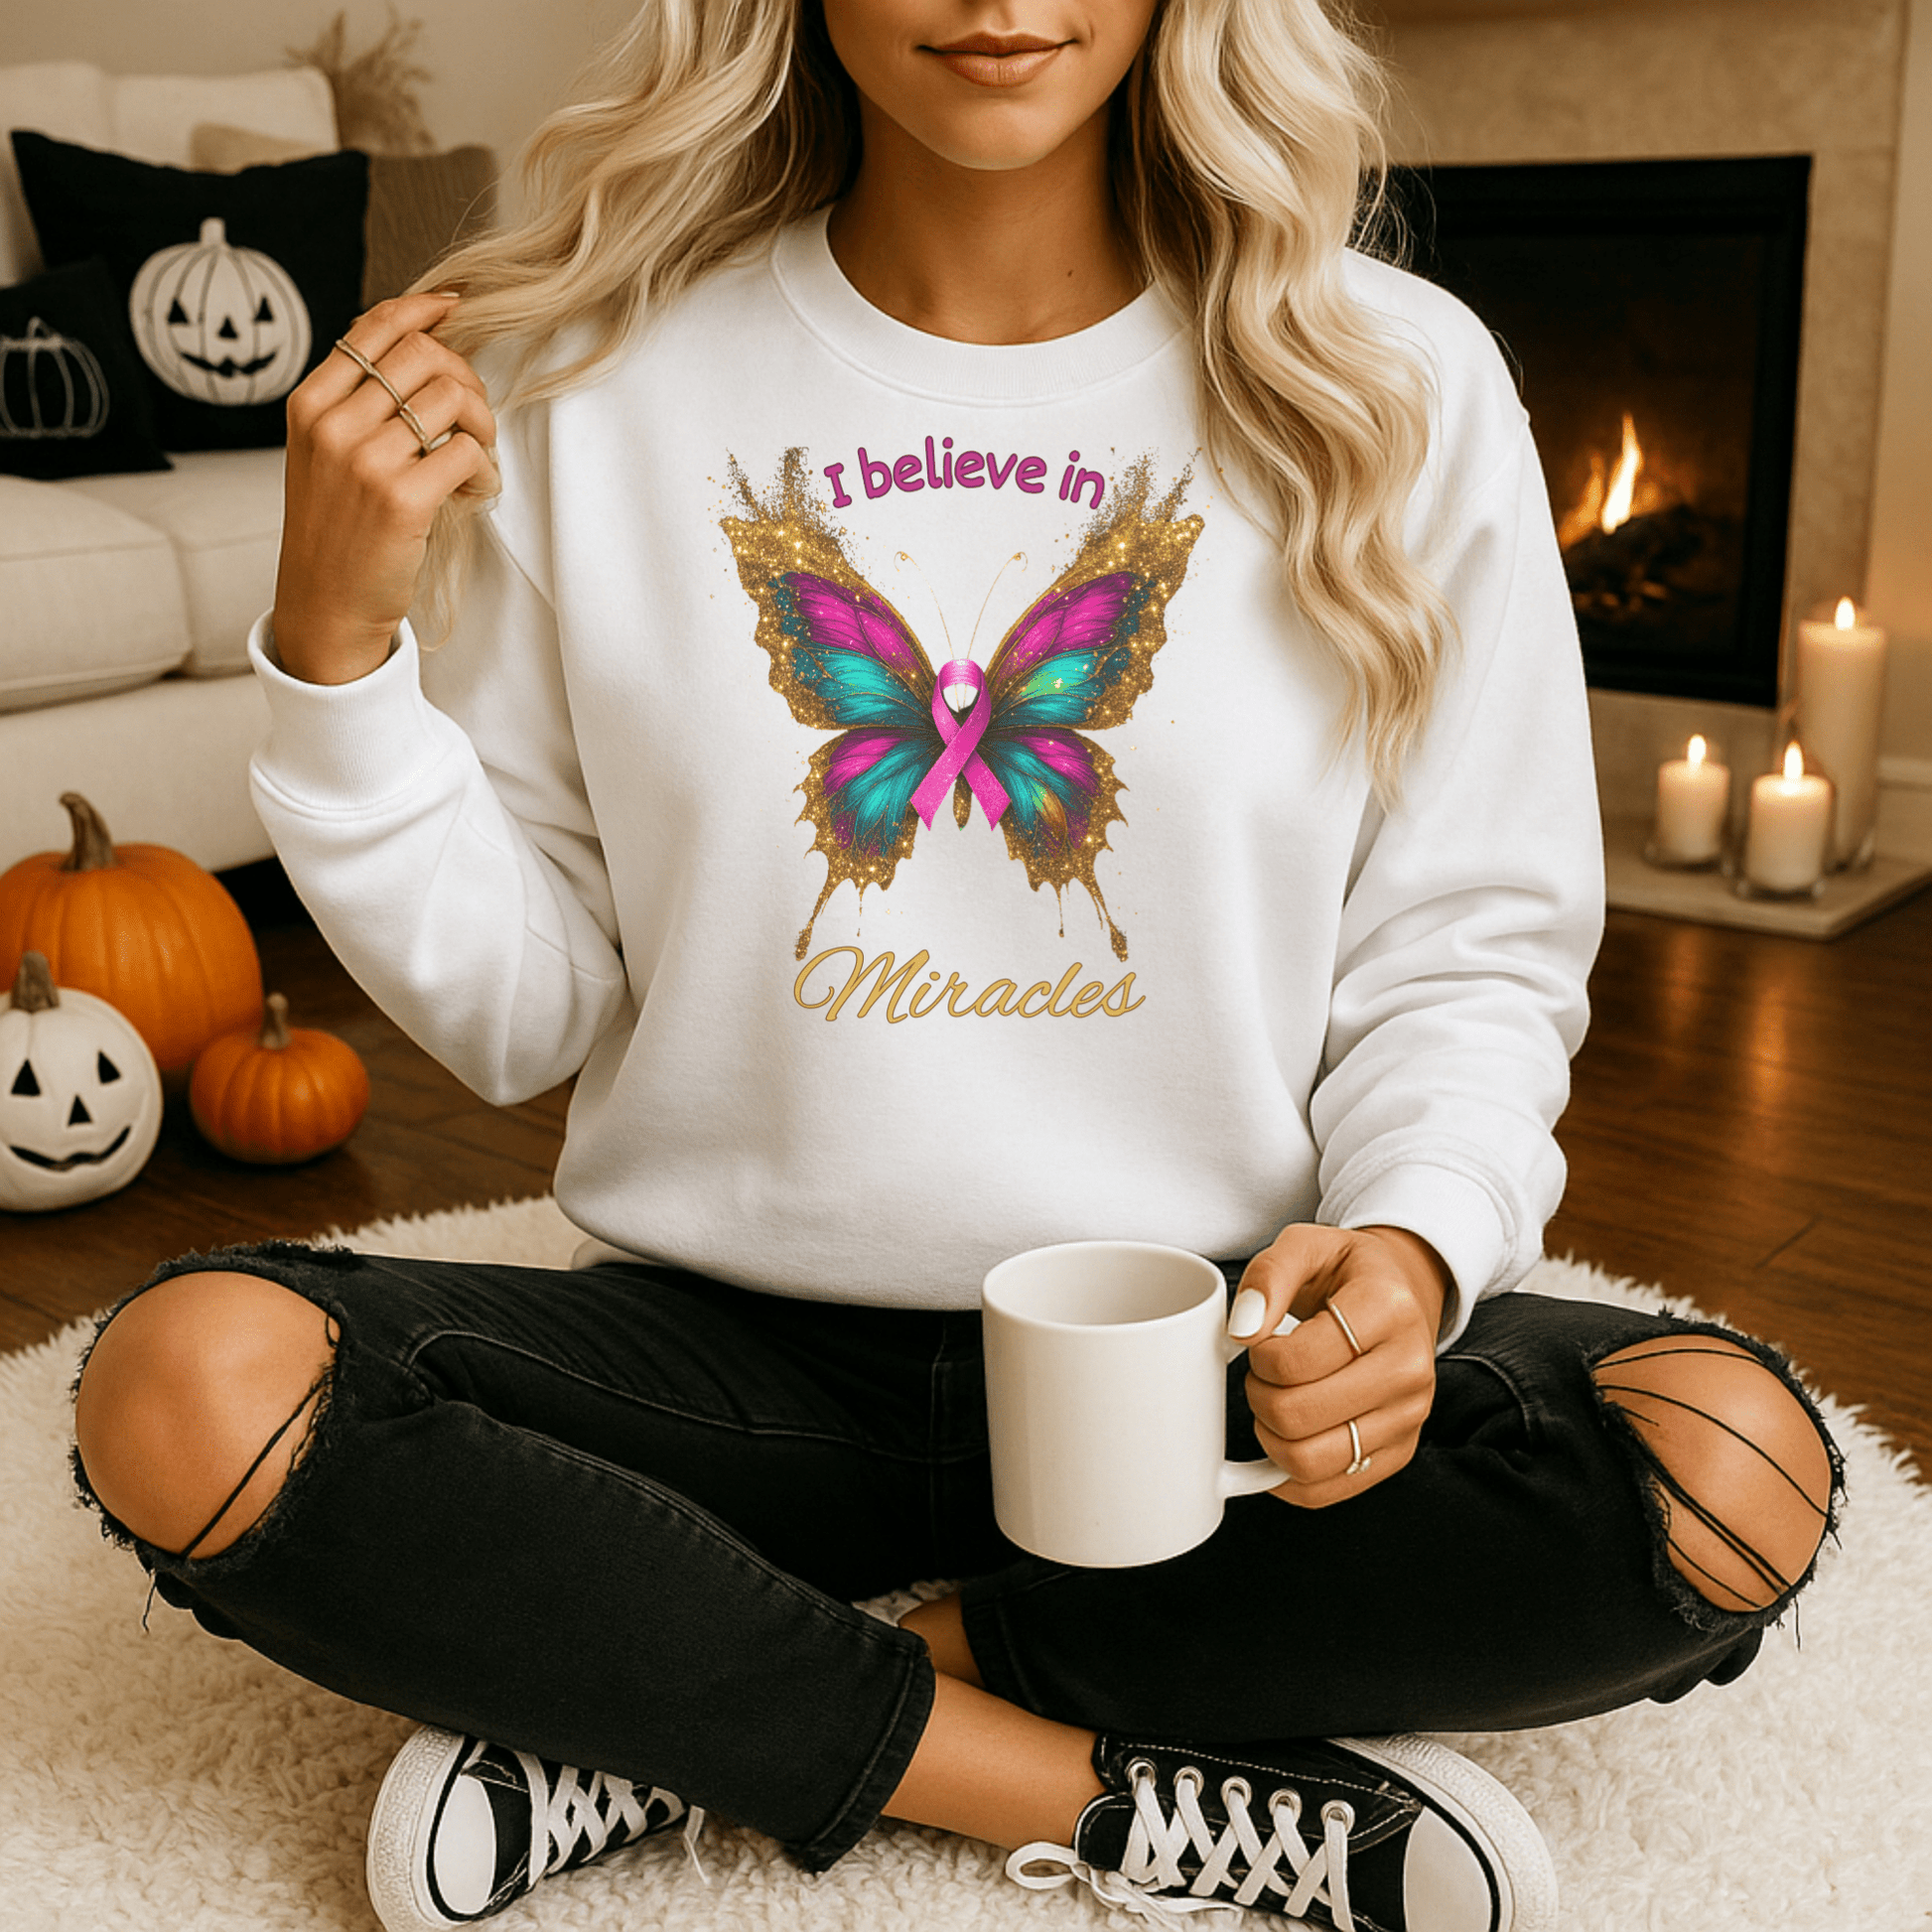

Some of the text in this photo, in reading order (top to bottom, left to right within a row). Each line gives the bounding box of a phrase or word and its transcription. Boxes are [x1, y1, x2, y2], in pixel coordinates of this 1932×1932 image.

[823, 436, 1105, 510] I believe in
[793, 945, 1147, 1025] Miracles
